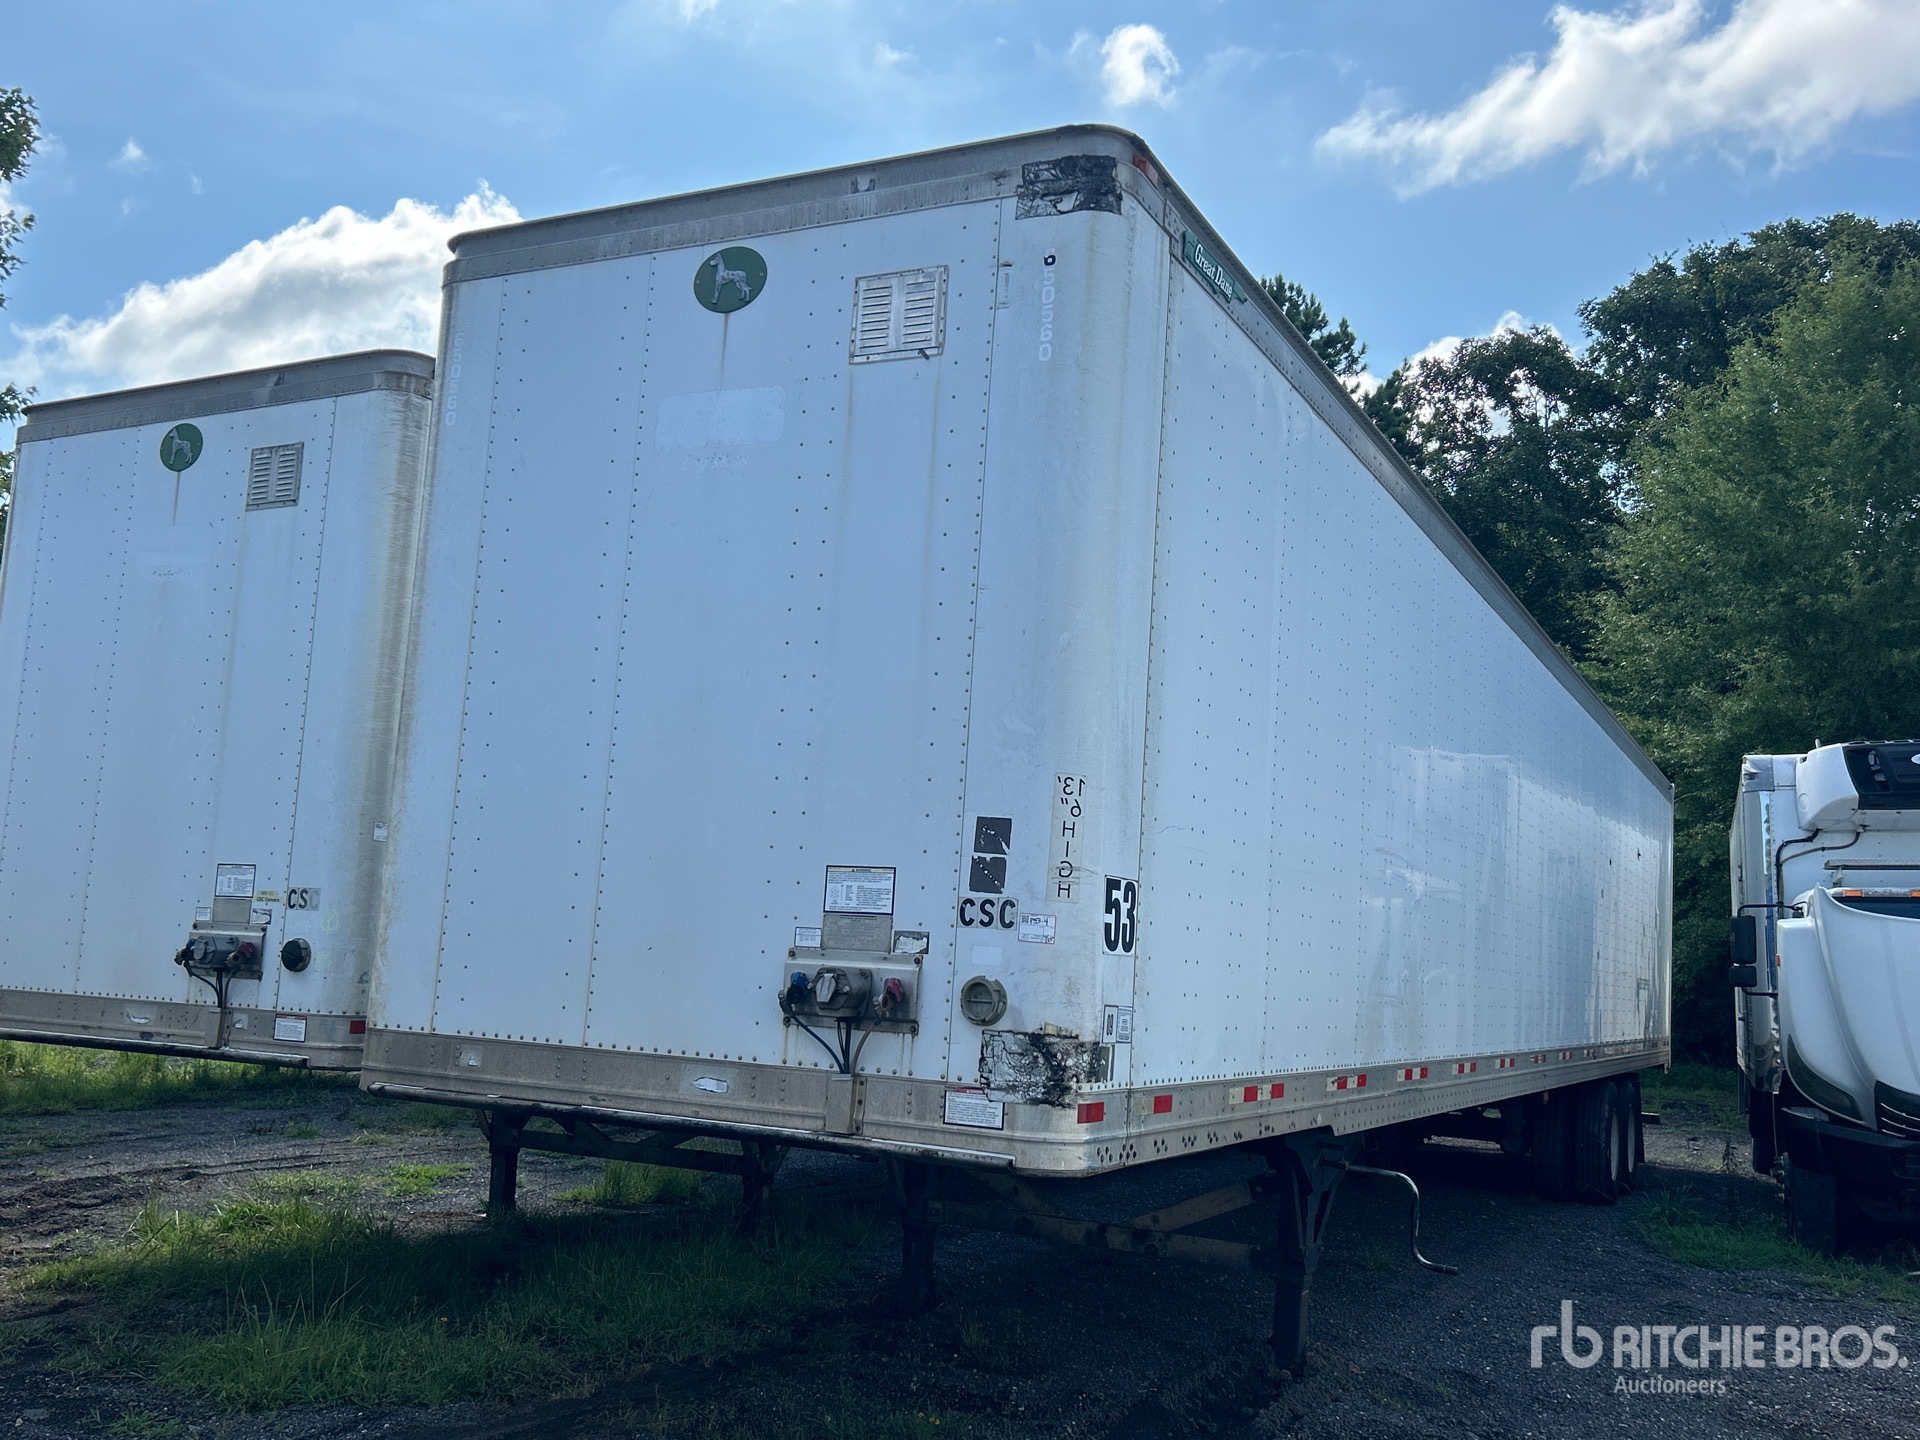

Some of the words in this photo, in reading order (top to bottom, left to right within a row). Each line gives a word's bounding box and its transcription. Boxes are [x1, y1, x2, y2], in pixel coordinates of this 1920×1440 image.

[1194, 243, 1216, 280] Great
[1214, 265, 1233, 298] Dane
[959, 898, 1015, 929] CSC
[1104, 877, 1137, 953] 53
